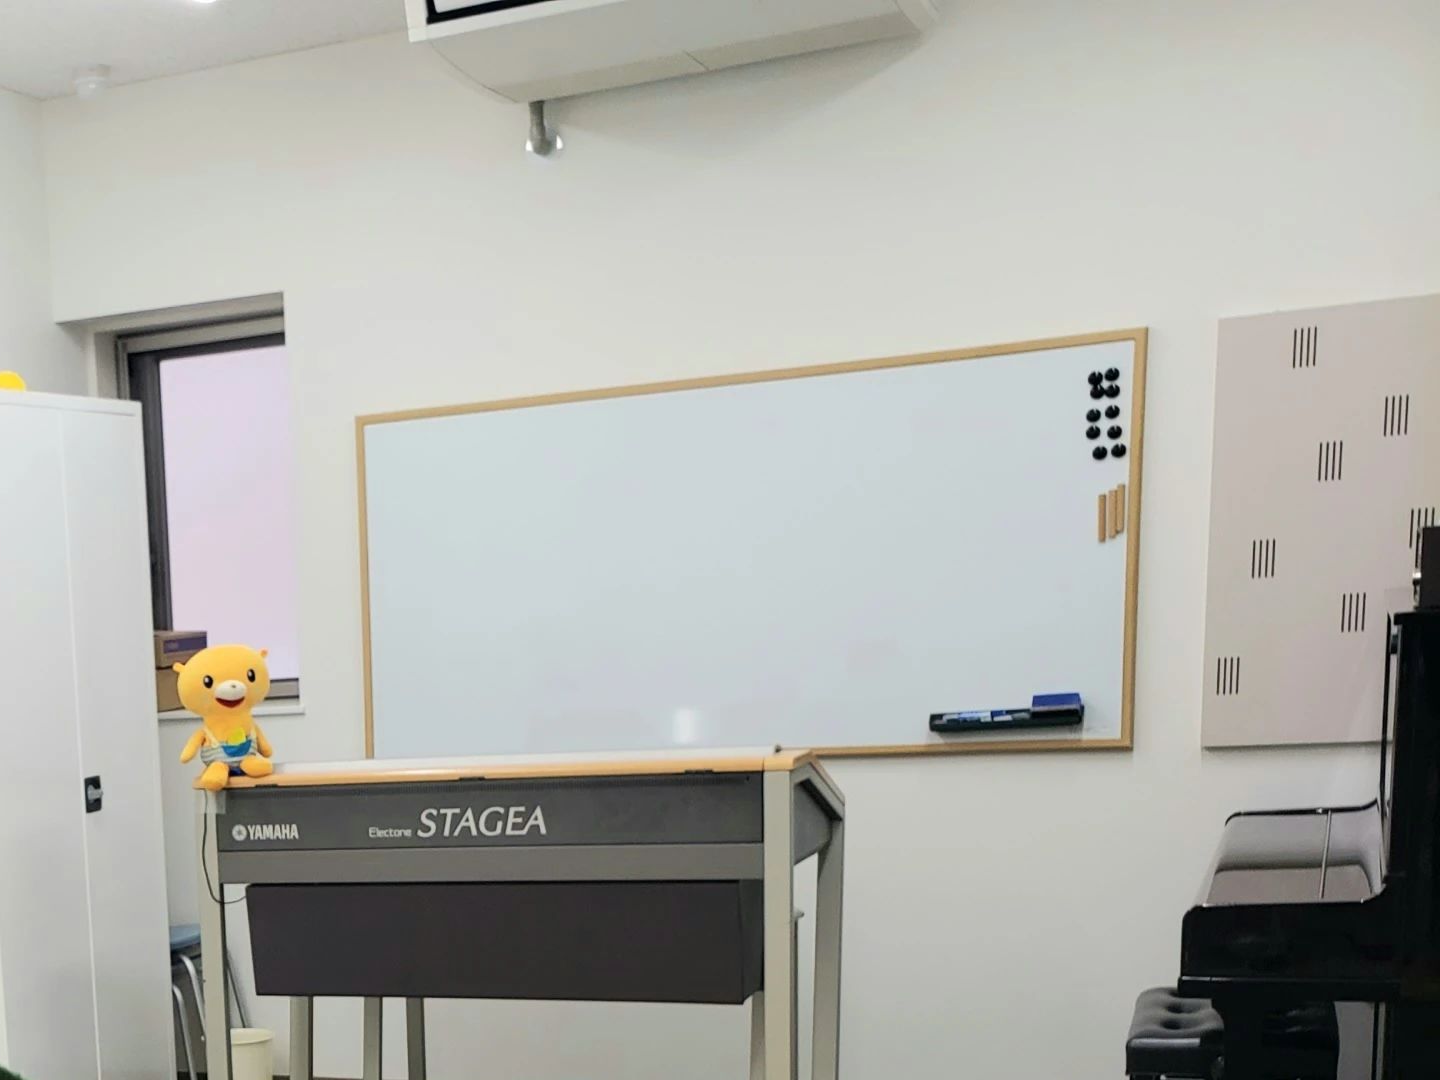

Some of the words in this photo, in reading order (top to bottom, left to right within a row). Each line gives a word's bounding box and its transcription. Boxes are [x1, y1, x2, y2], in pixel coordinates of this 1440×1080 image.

[247, 824, 300, 840] YAMAHA
[368, 826, 412, 839] Electone
[416, 805, 548, 838] STAGEA
